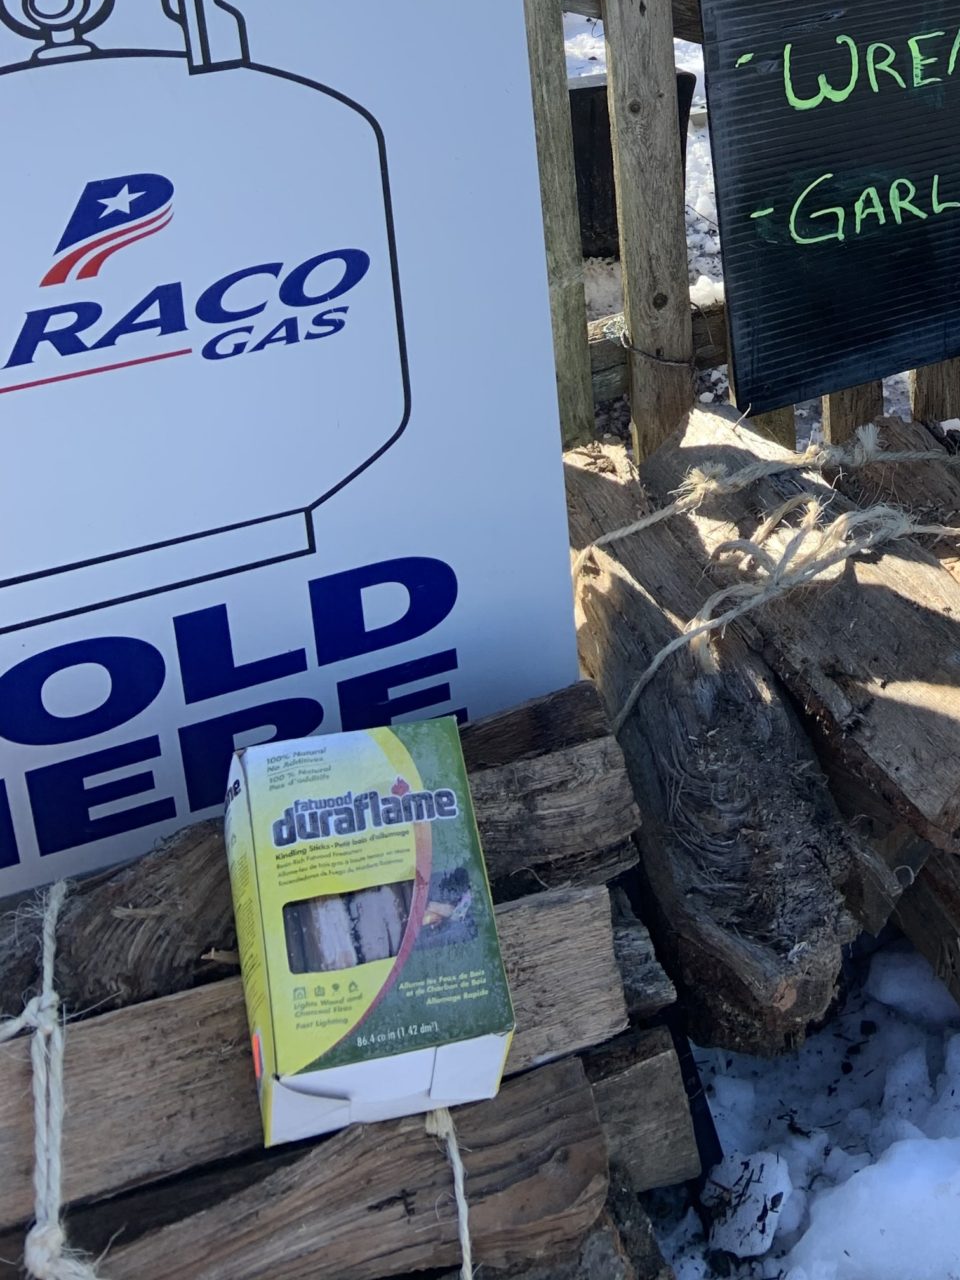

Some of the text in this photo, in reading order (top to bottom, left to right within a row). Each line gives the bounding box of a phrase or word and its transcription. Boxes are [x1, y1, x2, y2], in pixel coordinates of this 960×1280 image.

[1, 248, 371, 370] RACO
[200, 306, 350, 361] GAS
[272, 788, 457, 847] duraflame
[294, 791, 352, 814] fatwood
[275, 847, 307, 861] Kindling
[357, 1035, 375, 1047] 86.4
[388, 1031, 396, 1040] in
